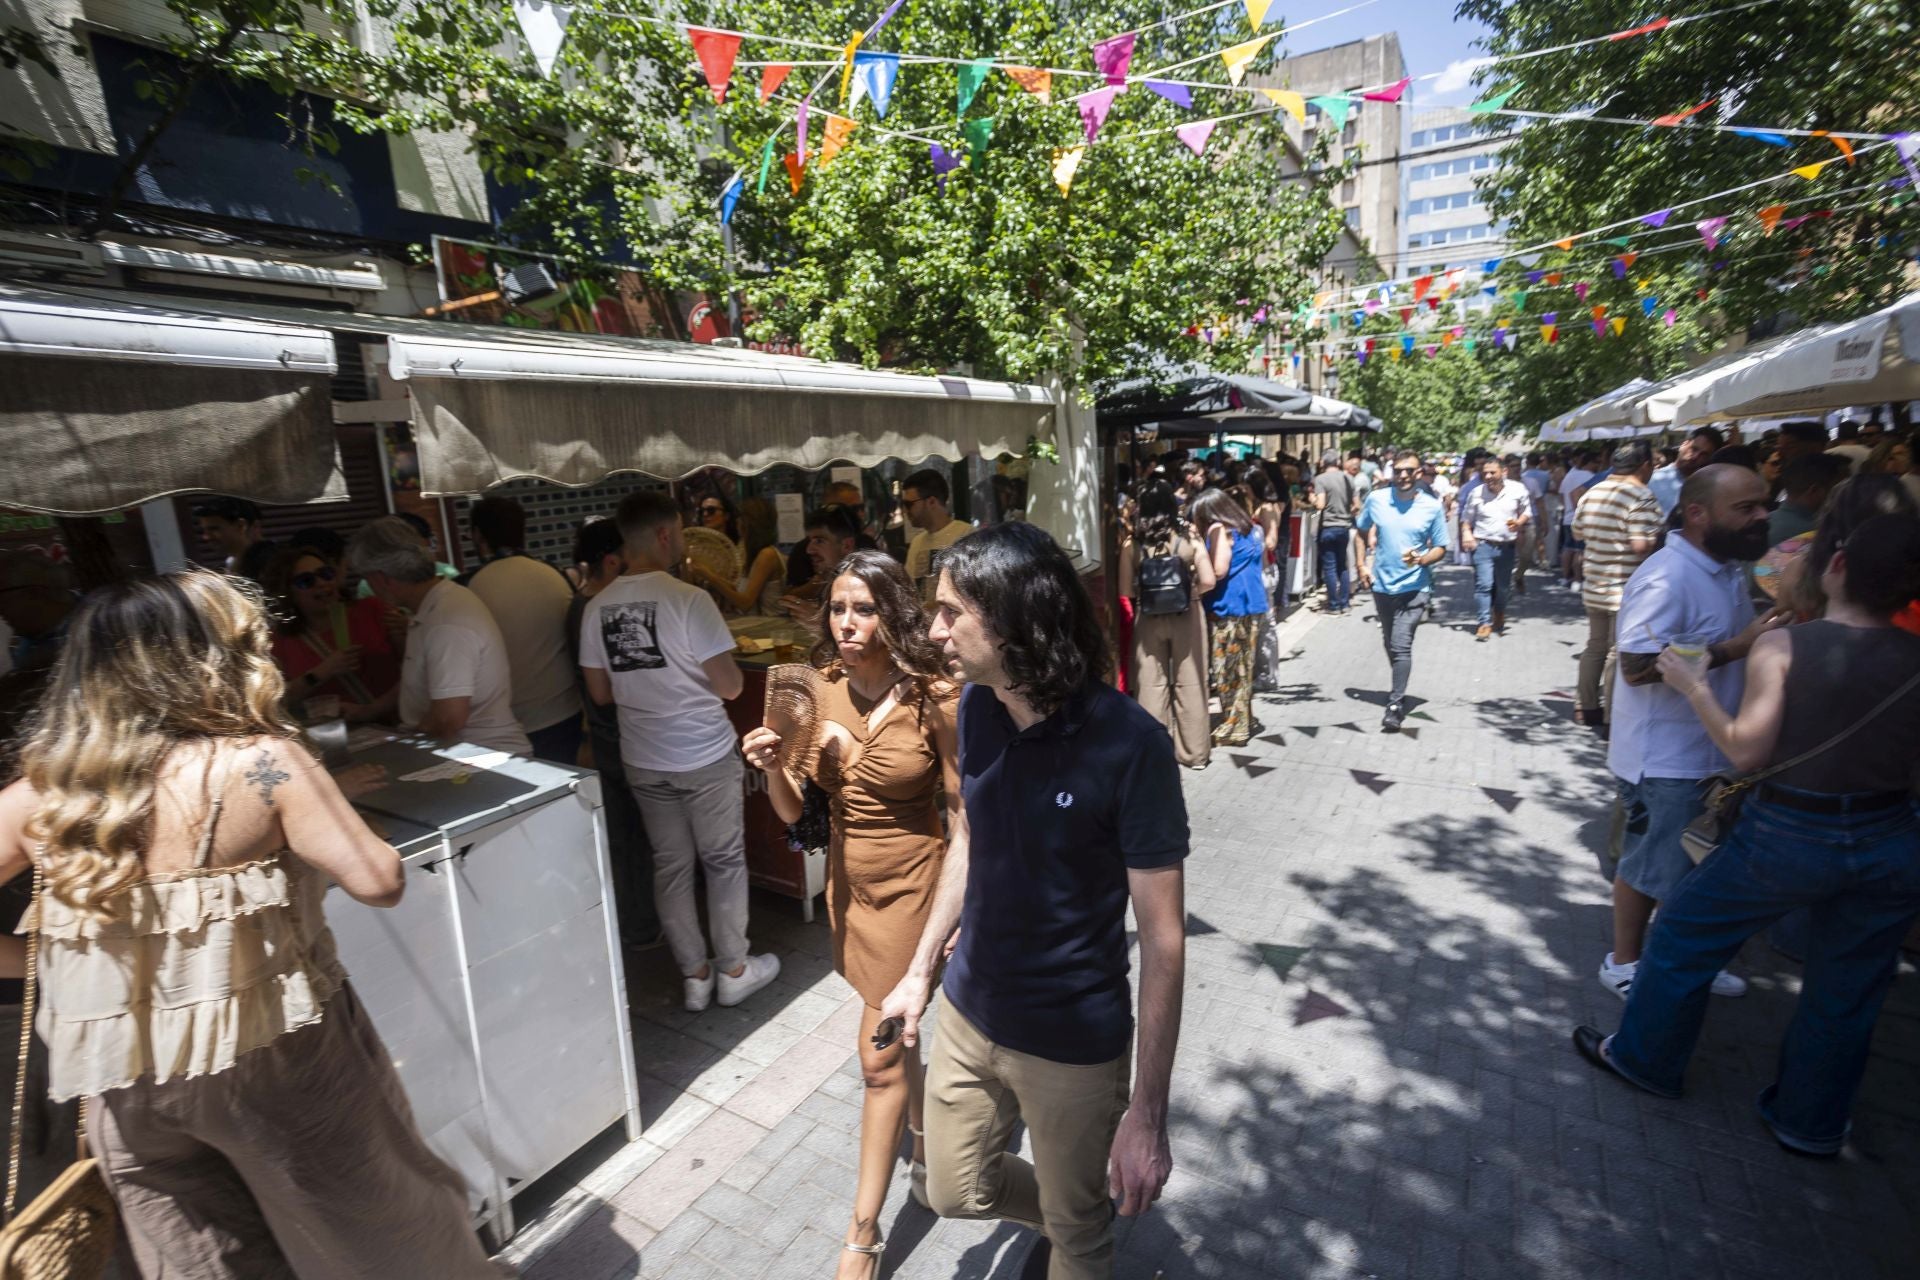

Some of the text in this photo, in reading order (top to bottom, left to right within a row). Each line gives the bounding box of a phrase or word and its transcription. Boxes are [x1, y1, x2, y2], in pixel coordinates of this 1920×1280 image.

[620, 624, 637, 633] THE
[607, 632, 638, 642] NORTH
[617, 640, 640, 649] FACE
